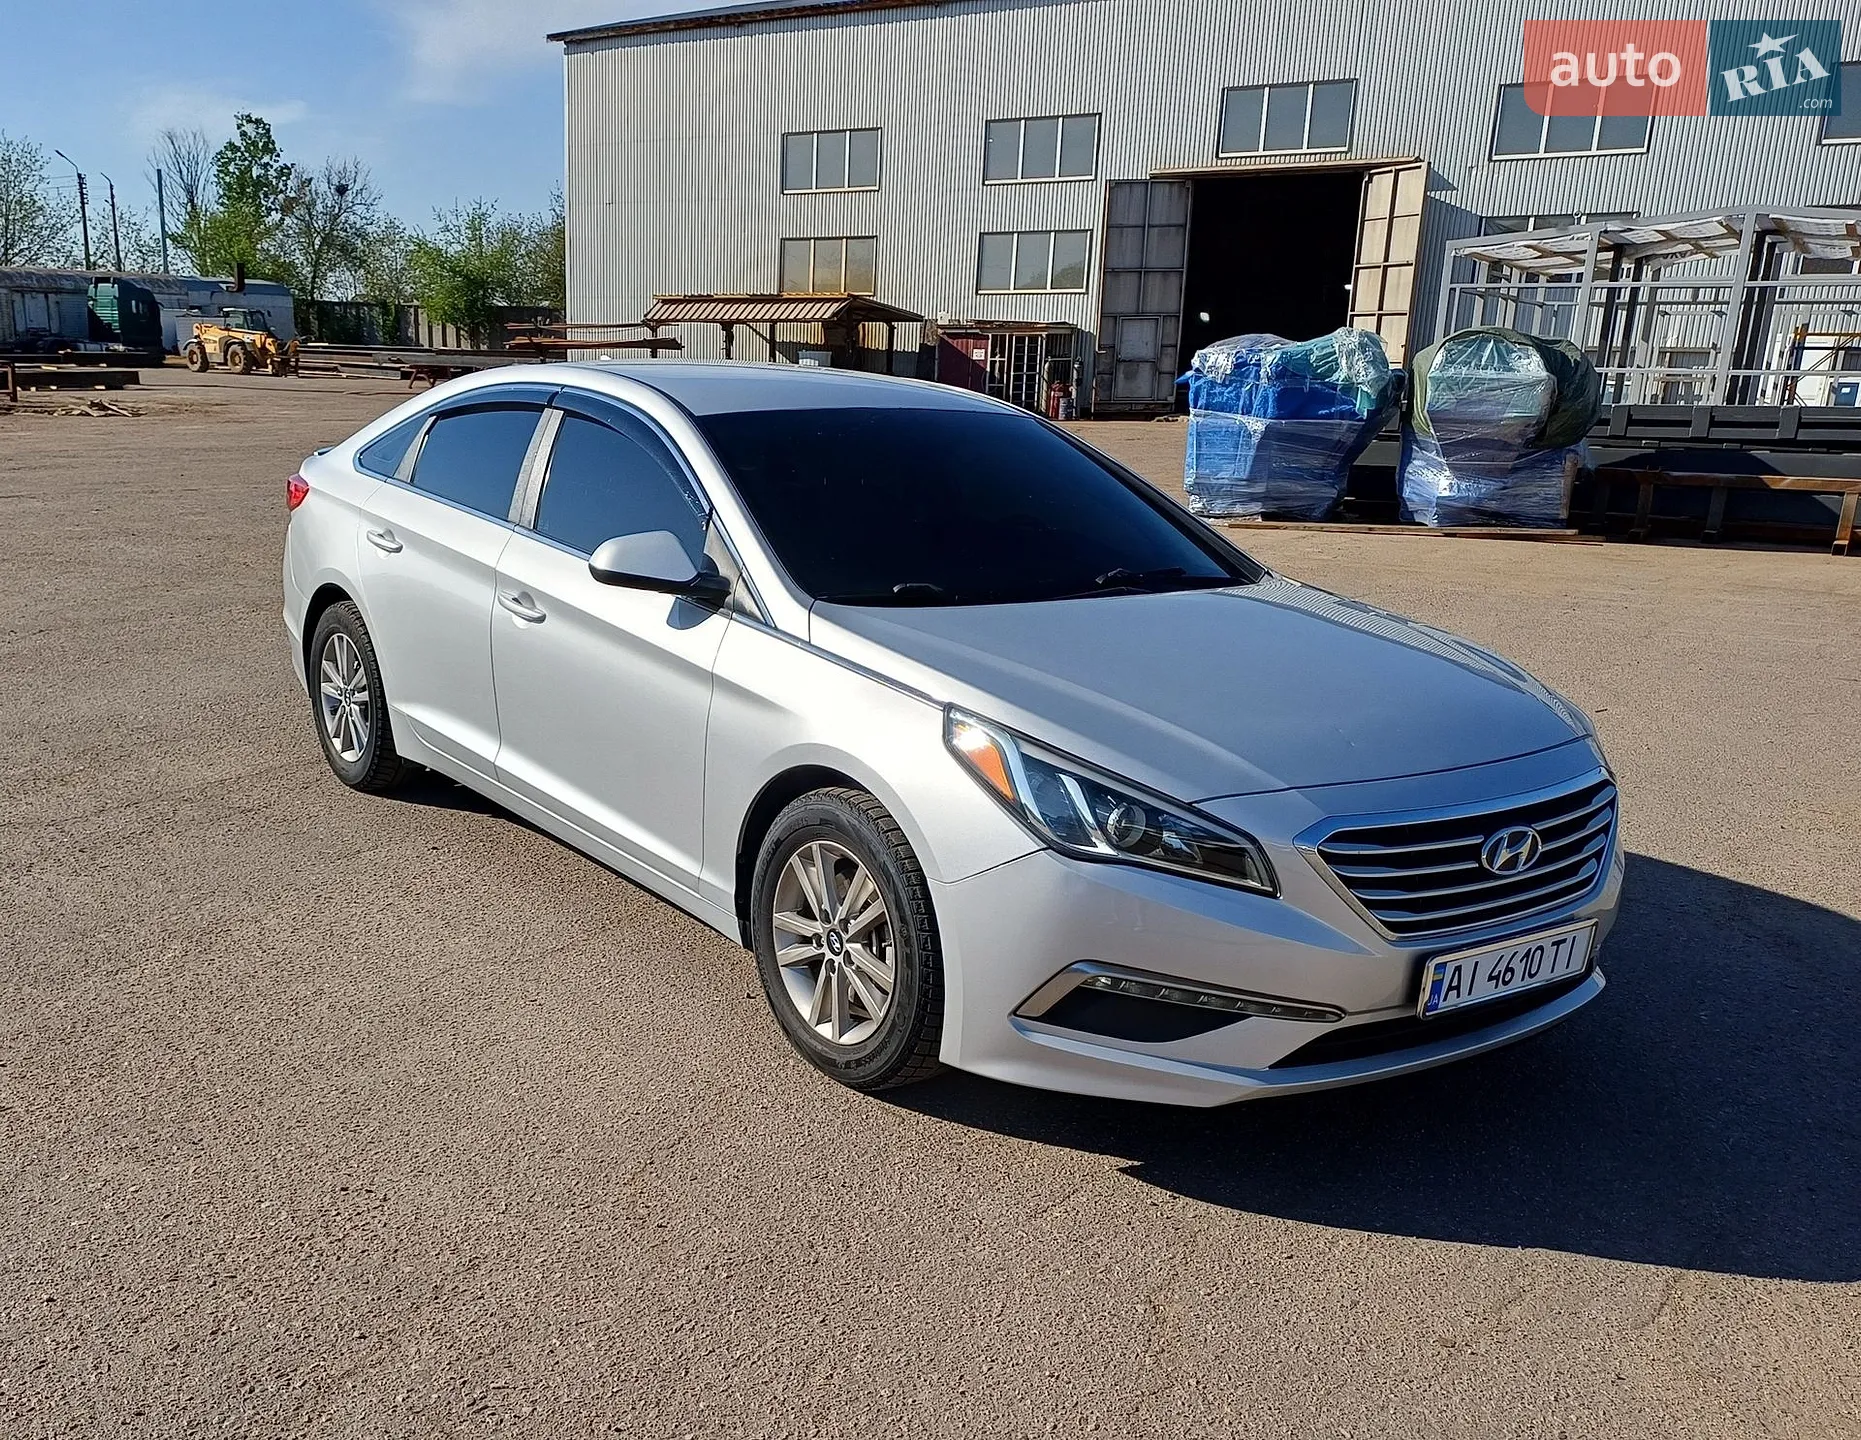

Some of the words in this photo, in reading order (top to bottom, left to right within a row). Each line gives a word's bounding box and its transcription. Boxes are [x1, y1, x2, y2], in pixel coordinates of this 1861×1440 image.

[1443, 960, 1479, 1002] AI
[1487, 945, 1544, 989] 4610
[1550, 936, 1577, 973] TI
